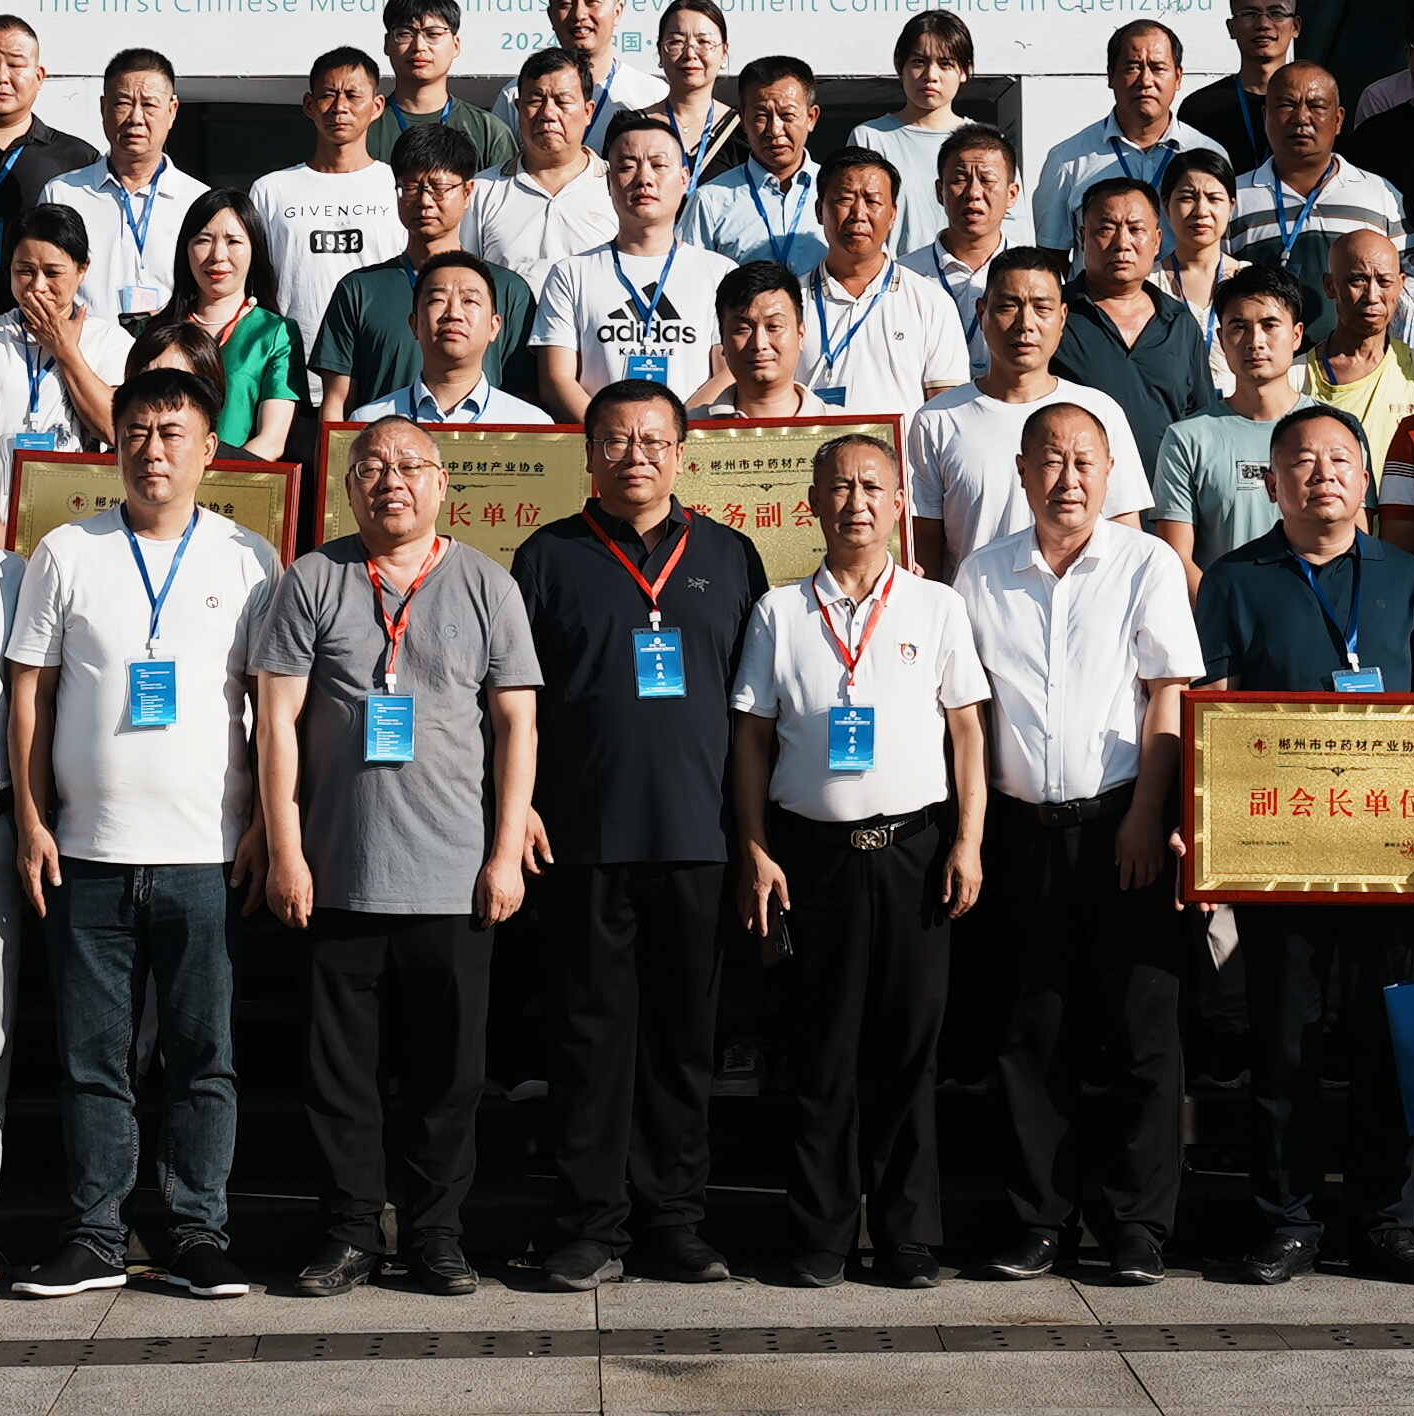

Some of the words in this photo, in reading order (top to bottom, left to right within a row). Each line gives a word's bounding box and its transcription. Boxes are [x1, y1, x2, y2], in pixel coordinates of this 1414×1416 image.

[284, 203, 390, 219] GIVENCHY
[314, 232, 359, 251] 1952
[596, 320, 697, 344] adidas
[618, 347, 675, 357] KARATE
[442, 461, 547, 473] 中药材产业协会
[95, 495, 127, 507] 郴州
